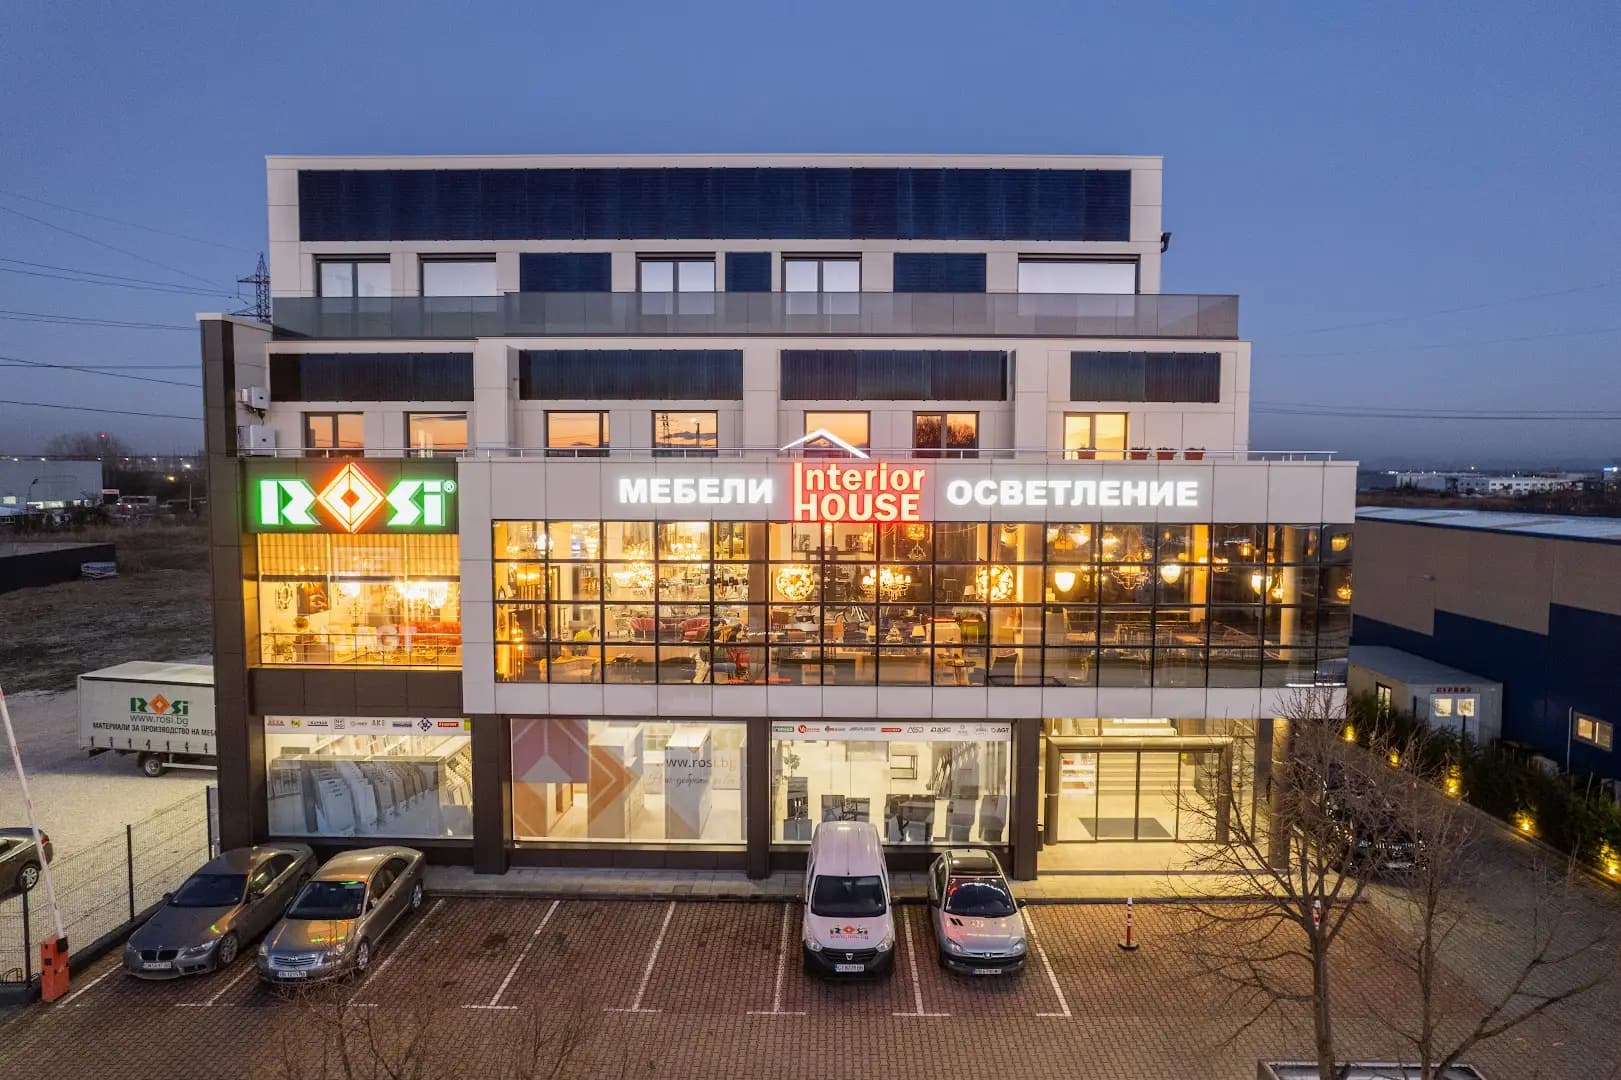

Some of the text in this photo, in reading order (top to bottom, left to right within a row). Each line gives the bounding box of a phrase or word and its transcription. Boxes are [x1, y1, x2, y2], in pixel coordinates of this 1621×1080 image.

[618, 477, 774, 505] МЕБЕЛИ
[794, 463, 926, 491] Interior
[946, 478, 1200, 507] ОСВЕТЛЕНИЕ
[794, 492, 920, 522] HOUSE
[92, 722, 131, 732] МАТЕРИАЛИ
[141, 726, 190, 735] ПРОИЗВОДСТВО
[130, 714, 189, 727] www.rosi.bg
